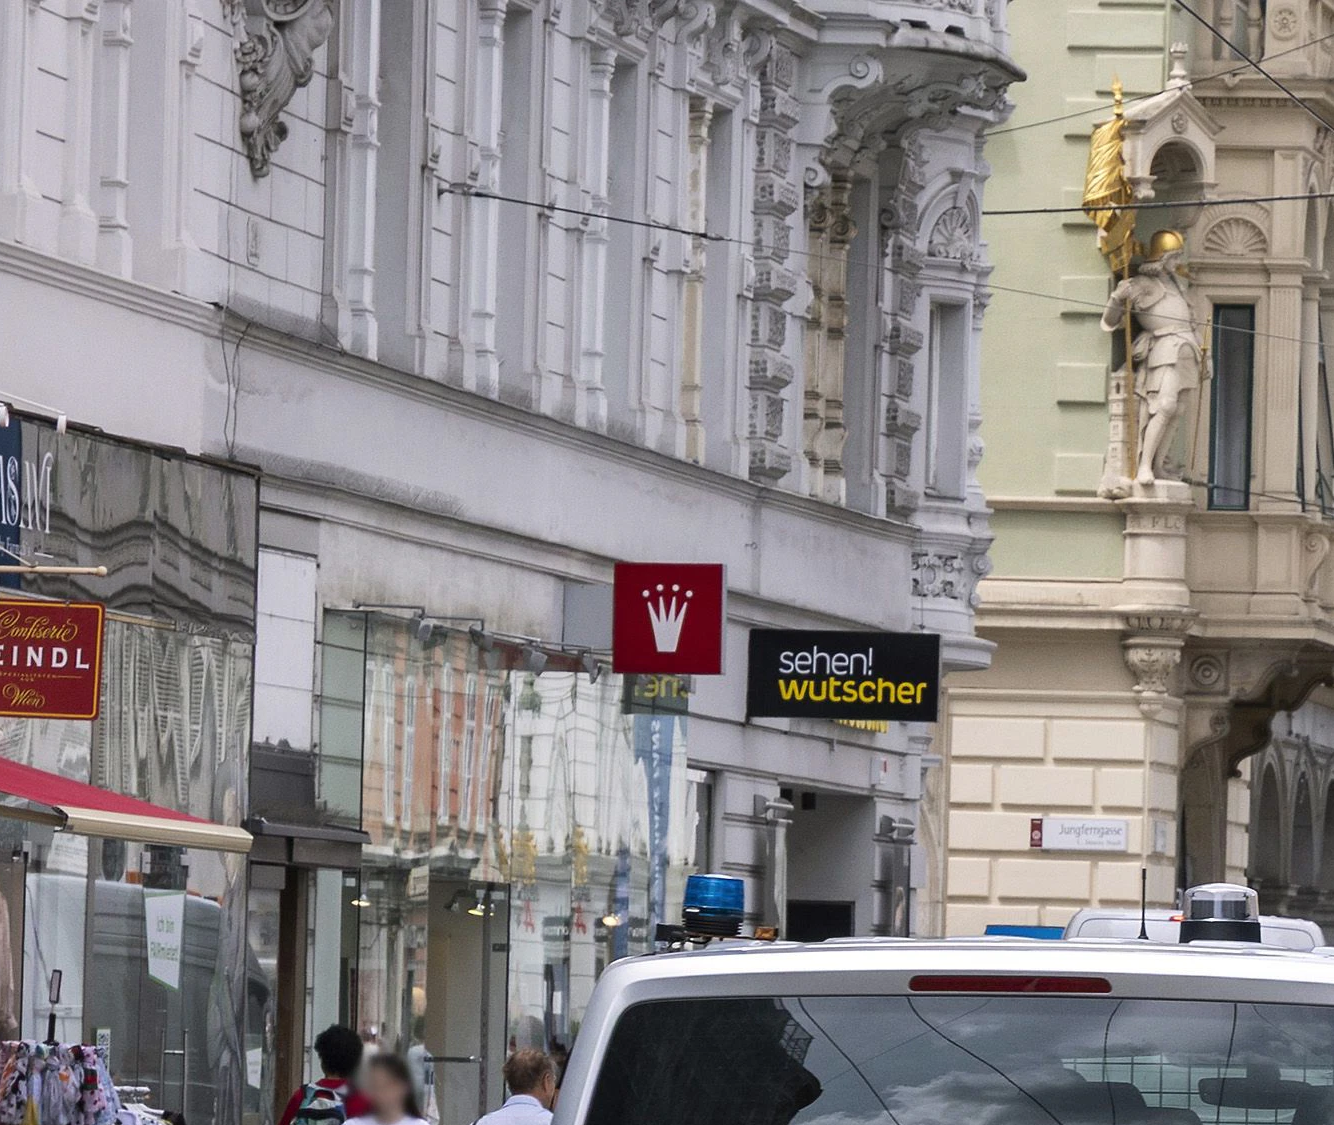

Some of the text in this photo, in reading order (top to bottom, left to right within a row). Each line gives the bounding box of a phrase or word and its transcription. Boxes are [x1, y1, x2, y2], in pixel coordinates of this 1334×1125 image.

[779, 645, 873, 676] sehen!
[2, 683, 45, 708] Wien
[778, 677, 927, 704] wutscher
[1059, 824, 1122, 838] Jungferngasse
